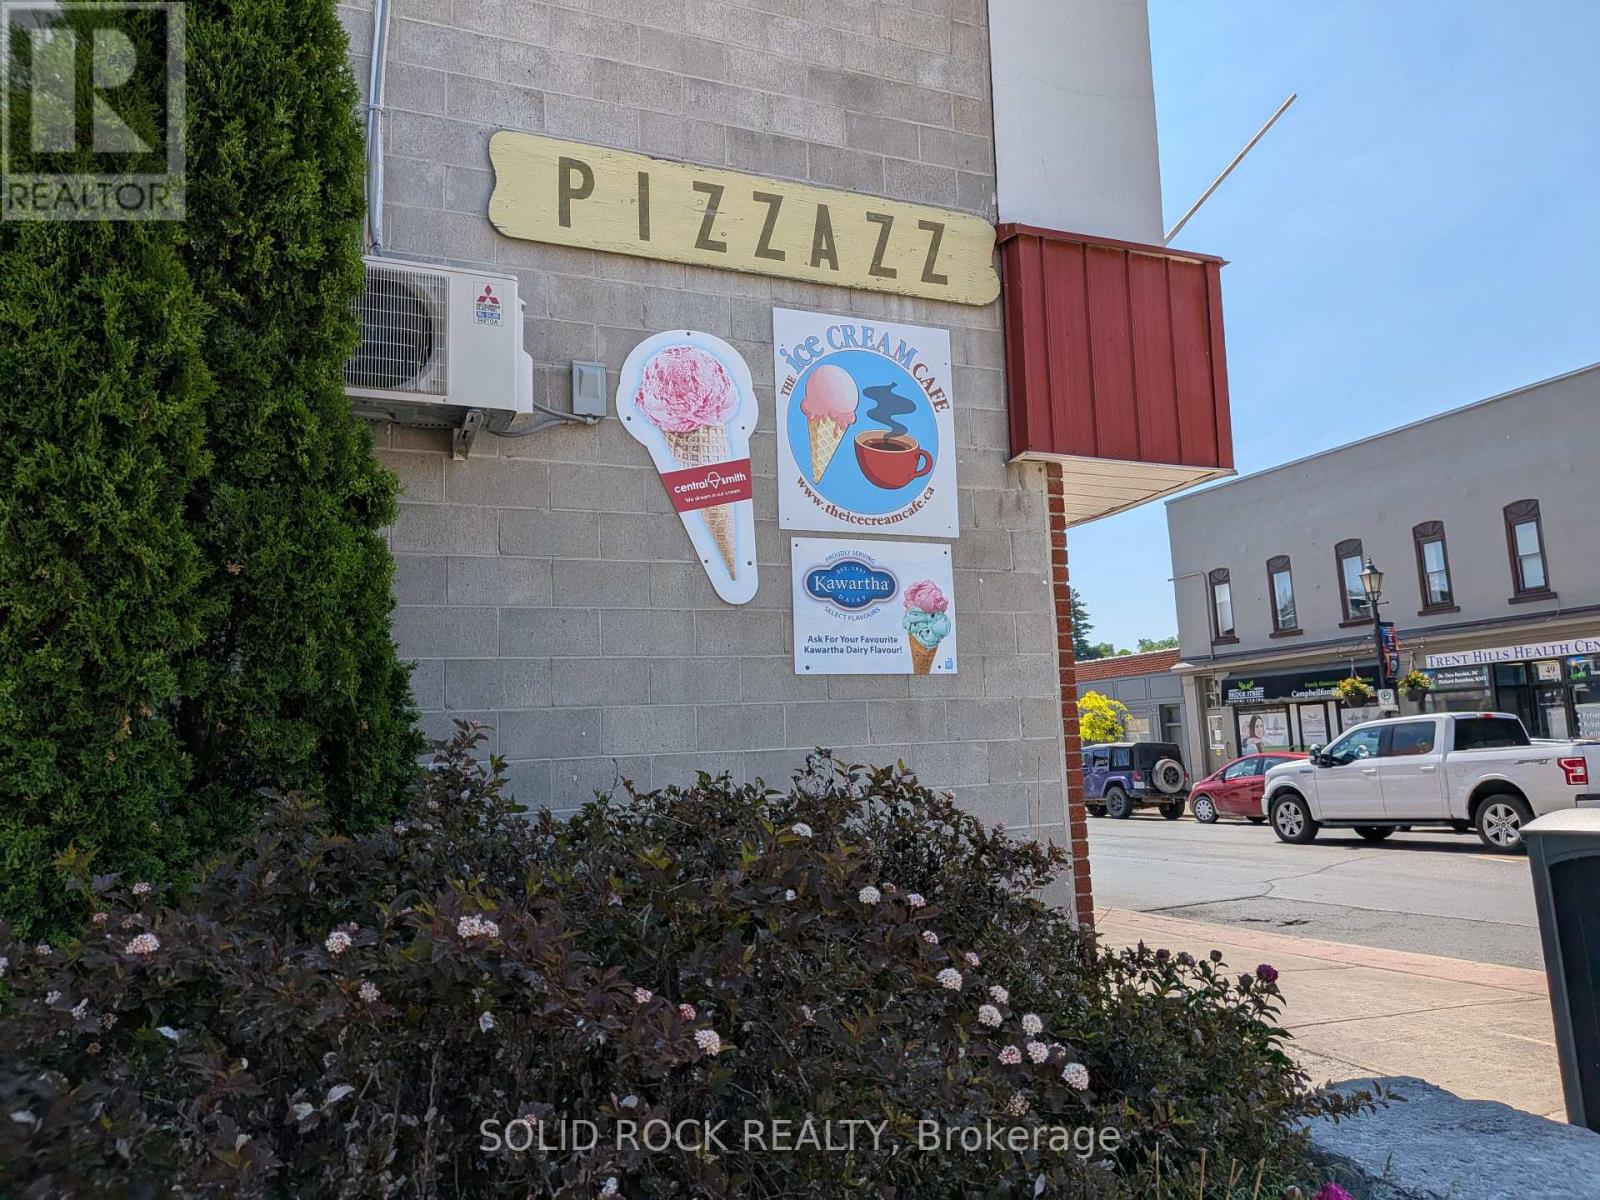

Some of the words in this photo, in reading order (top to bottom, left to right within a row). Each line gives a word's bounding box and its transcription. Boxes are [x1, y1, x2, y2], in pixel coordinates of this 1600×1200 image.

[558, 155, 949, 285] PIZZAZZ
[780, 374, 797, 397] THE
[826, 324, 918, 370] CREAM
[912, 362, 950, 413] CAFE
[674, 479, 708, 493] central
[721, 472, 747, 485] smith
[797, 476, 935, 526] www.theicecreamcafe.ca
[825, 550, 851, 562] PROUDLY
[852, 550, 876, 564] SERVING
[814, 576, 889, 592] Kawartha
[824, 606, 847, 620] SELECT
[848, 607, 880, 621] FLAVOURS
[807, 635, 823, 643] Ask
[839, 635, 859, 643] Your
[860, 635, 898, 643] Favourite
[804, 646, 845, 654] Kawartha
[846, 646, 868, 656] Dairy
[870, 646, 902, 654] Flavour!
[1428, 654, 1468, 667] TRENT
[1473, 649, 1510, 663] HILLS
[1514, 643, 1569, 658] HEALTH
